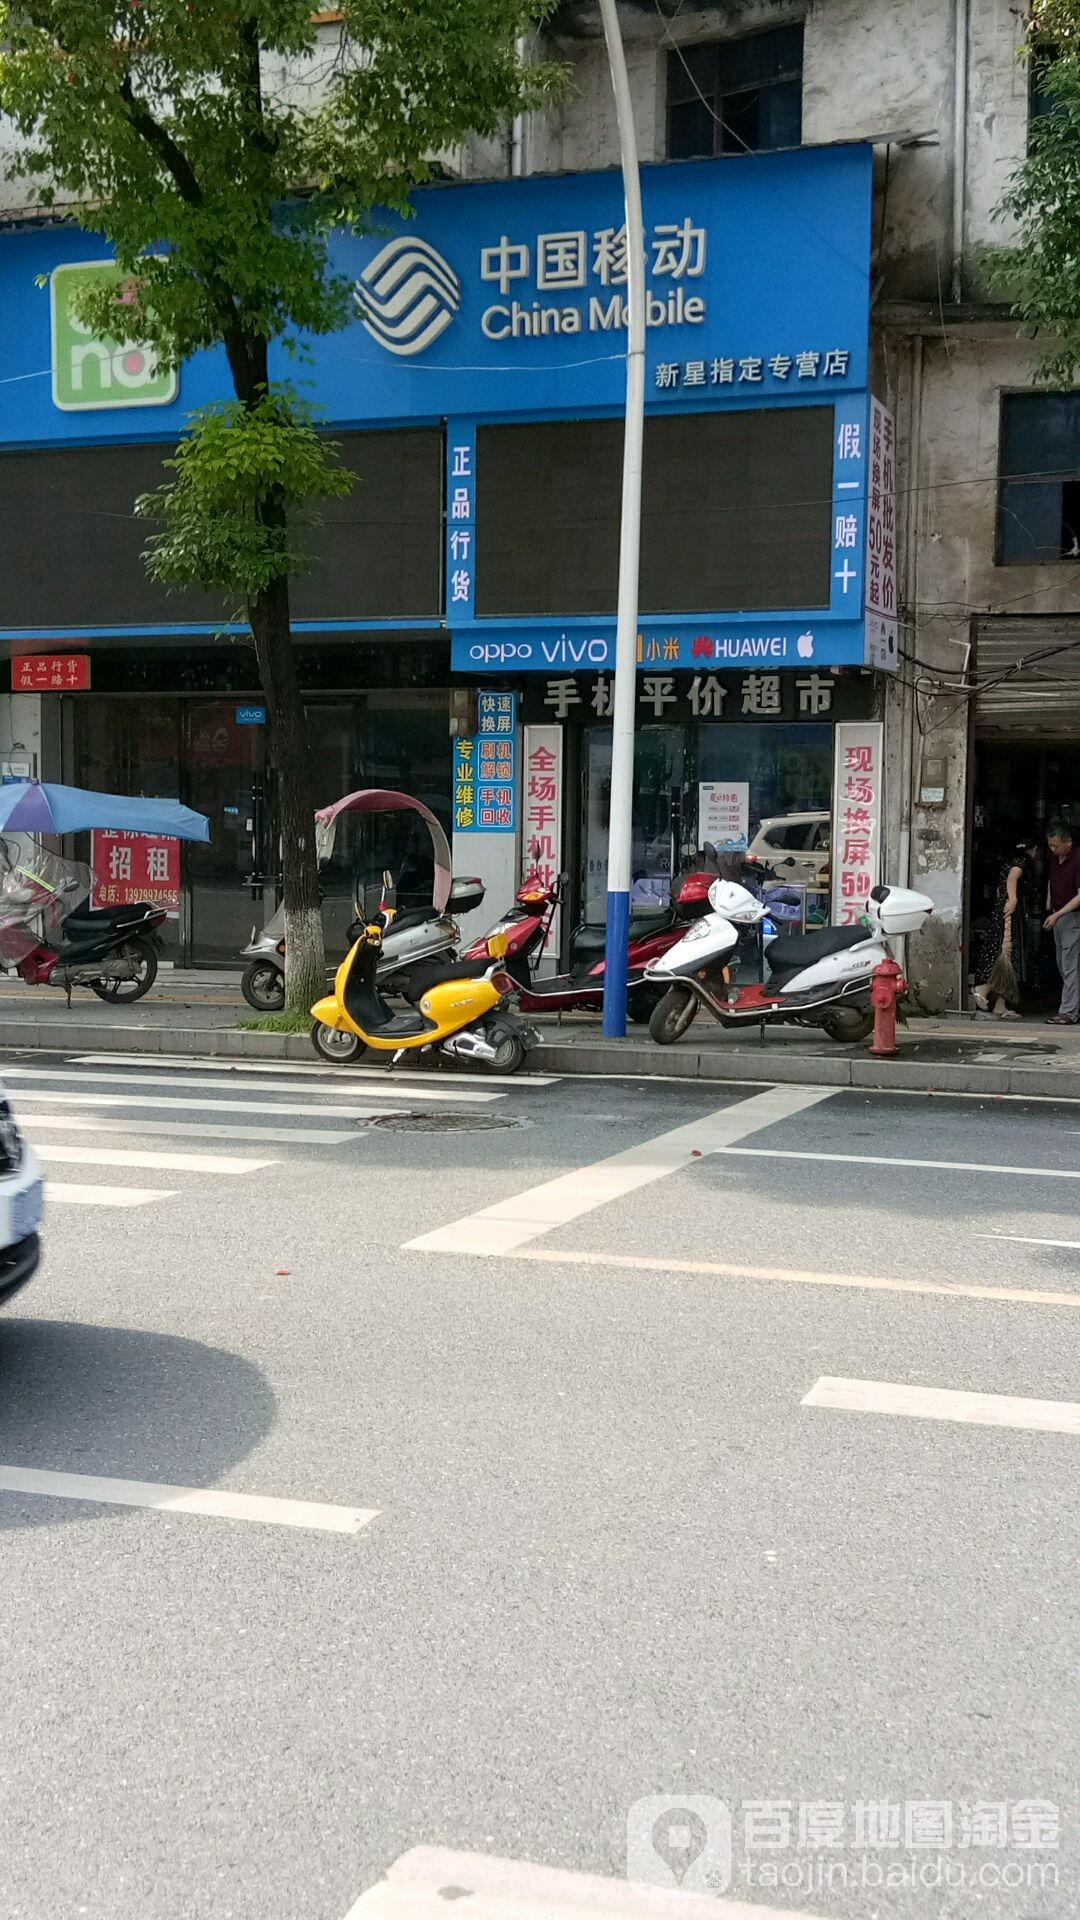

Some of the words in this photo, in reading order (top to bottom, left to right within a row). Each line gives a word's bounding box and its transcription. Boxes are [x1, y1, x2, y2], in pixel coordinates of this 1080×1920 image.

[481, 217, 707, 295] 中国移动
[481, 301, 581, 340] China
[655, 349, 849, 388] 新星指定专营店
[834, 423, 861, 594] 假一赔十
[869, 406, 882, 606] 现场换屏50元起
[882, 415, 894, 610] 手机批发价
[450, 446, 471, 602] 正品行货
[541, 633, 608, 663] vivo
[646, 637, 679, 662] 小米
[714, 637, 787, 658] HUAWEI
[20, 659, 78, 674] 正品行货
[20, 673, 78, 687] 假一赔十
[481, 696, 511, 713] 快速
[544, 674, 836, 718] 手机平价超市
[481, 715, 511, 733] 换屏
[481, 742, 511, 760] 刷机
[455, 739, 474, 828] 专业维修
[480, 761, 511, 779] 解锁
[480, 789, 511, 806] 手机
[480, 808, 511, 825] 回收
[109, 845, 169, 881] 招租
